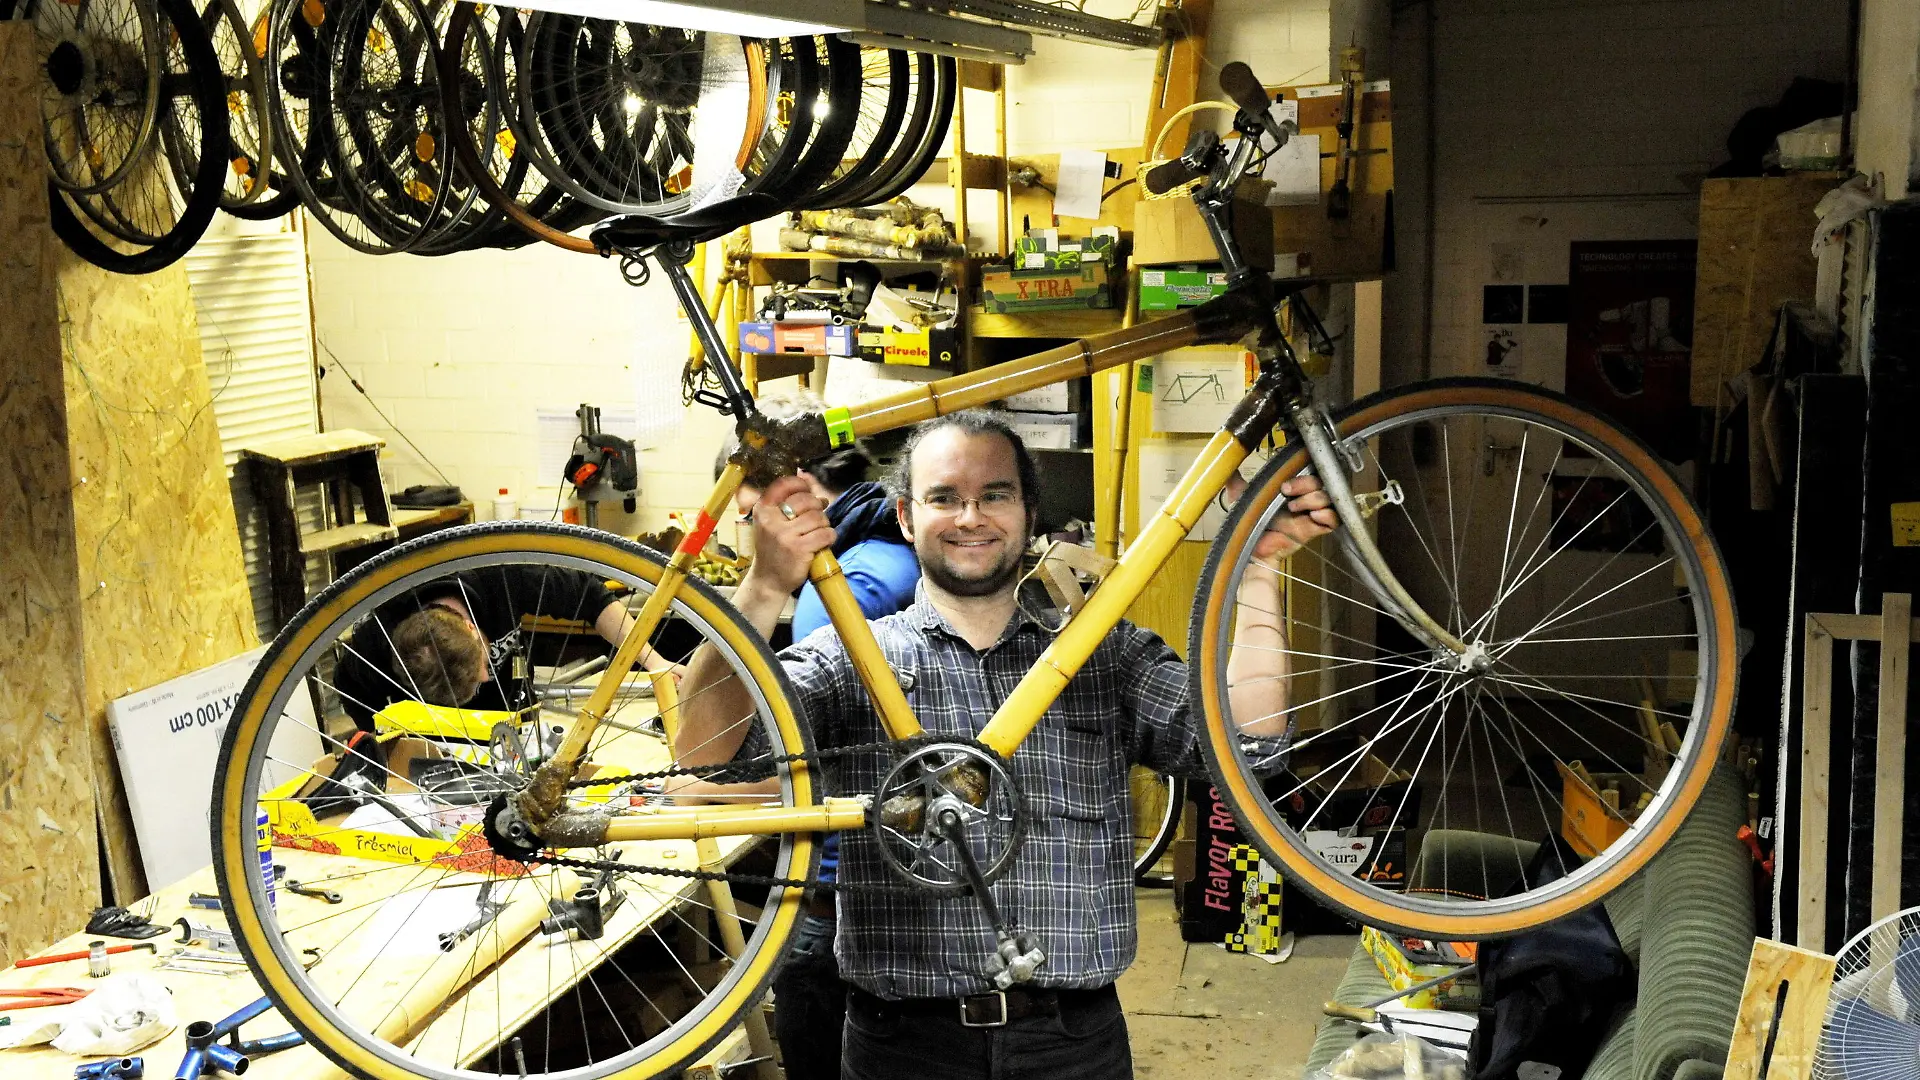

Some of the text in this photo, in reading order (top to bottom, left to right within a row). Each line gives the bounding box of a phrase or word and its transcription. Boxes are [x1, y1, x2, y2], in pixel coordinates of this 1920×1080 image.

[1579, 252, 1635, 261] TECHNOLOGY
[1638, 252, 1678, 261] CREATES
[1016, 278, 1075, 300] X TRA
[168, 711, 194, 734] cm
[1205, 834, 1232, 912] Flavor
